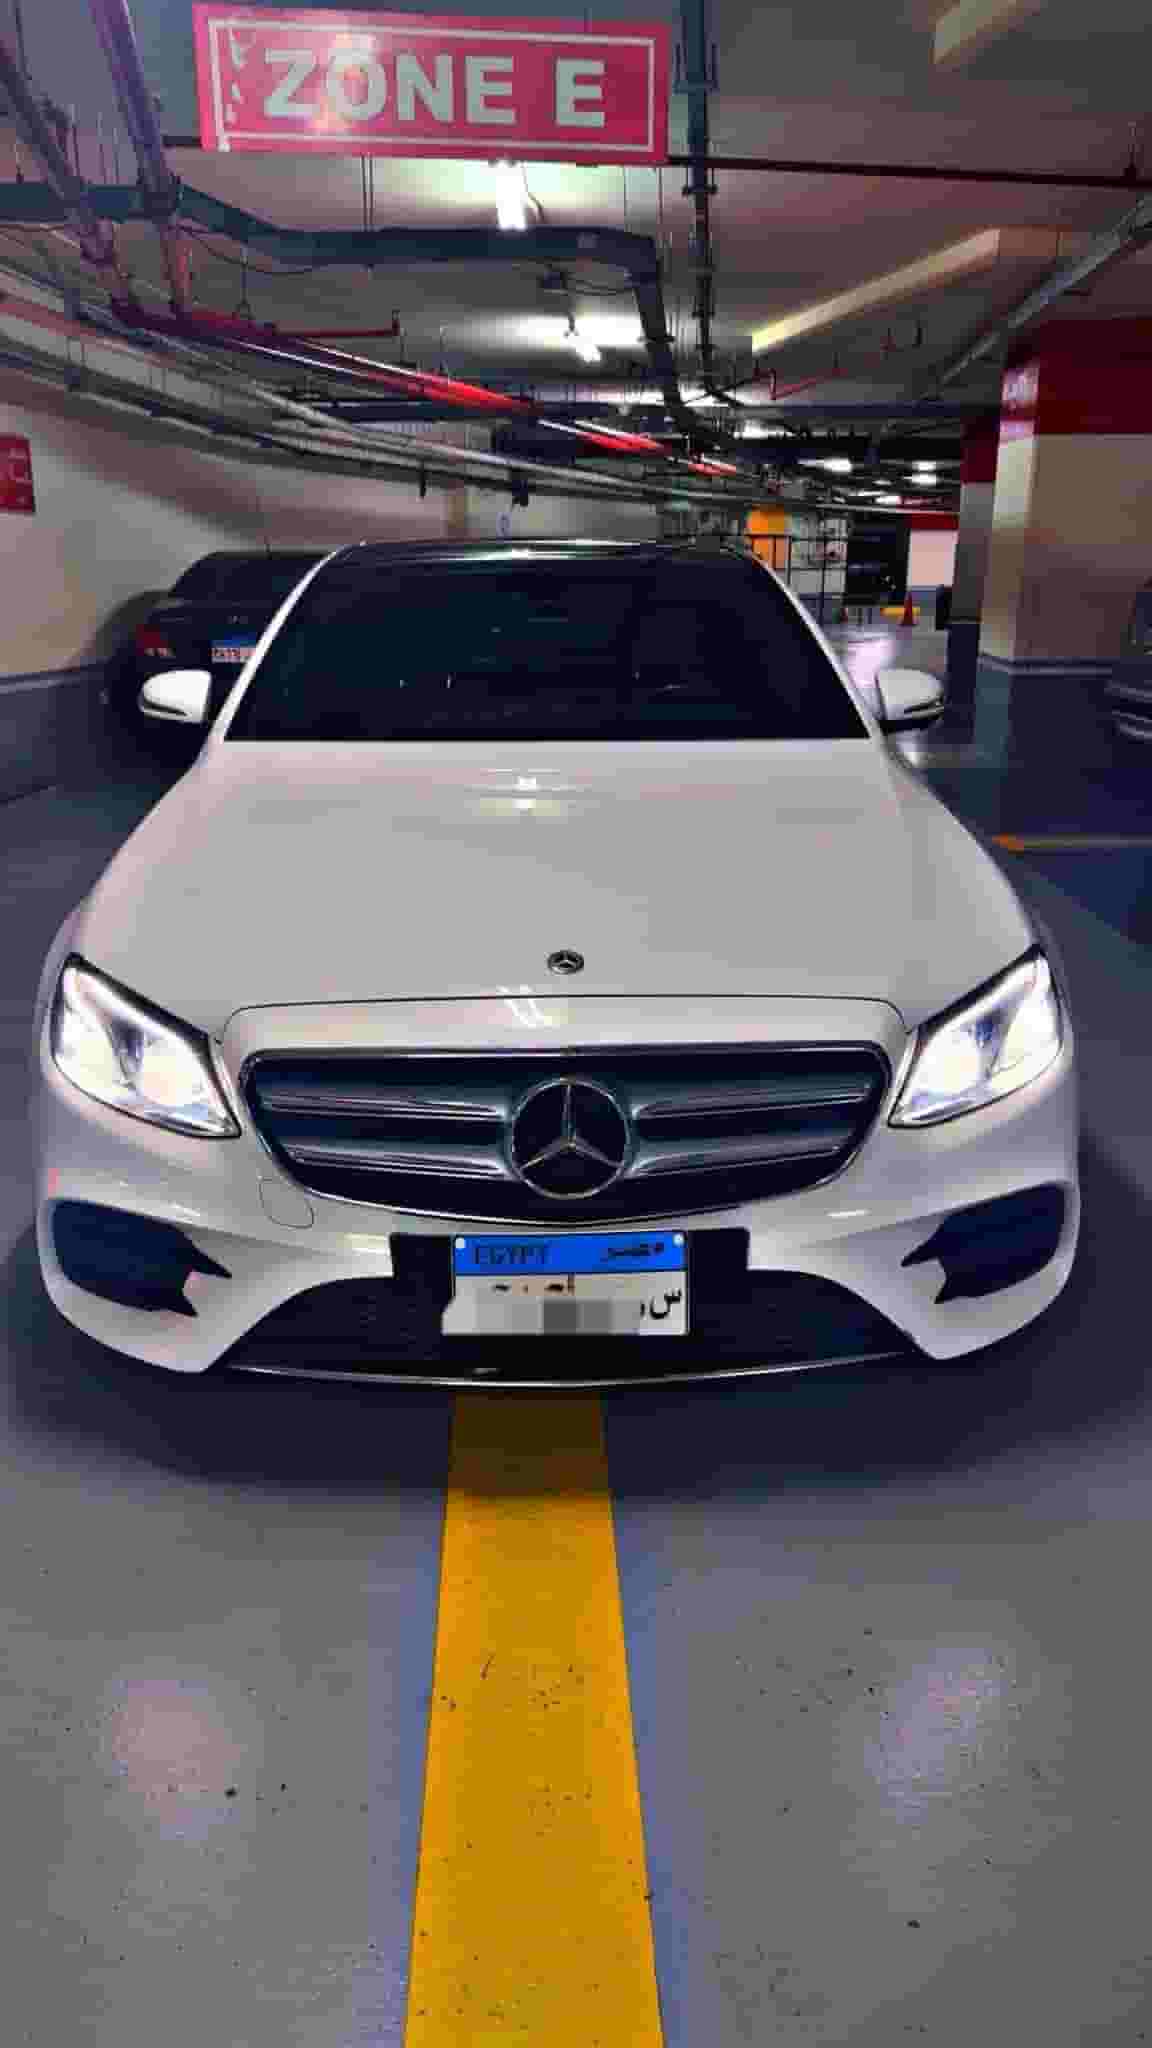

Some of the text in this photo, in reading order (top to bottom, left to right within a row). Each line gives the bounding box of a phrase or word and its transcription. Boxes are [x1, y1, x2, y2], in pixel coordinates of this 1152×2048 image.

[264, 46, 606, 128] ZONE E
[474, 1243, 551, 1265] EGYPT
